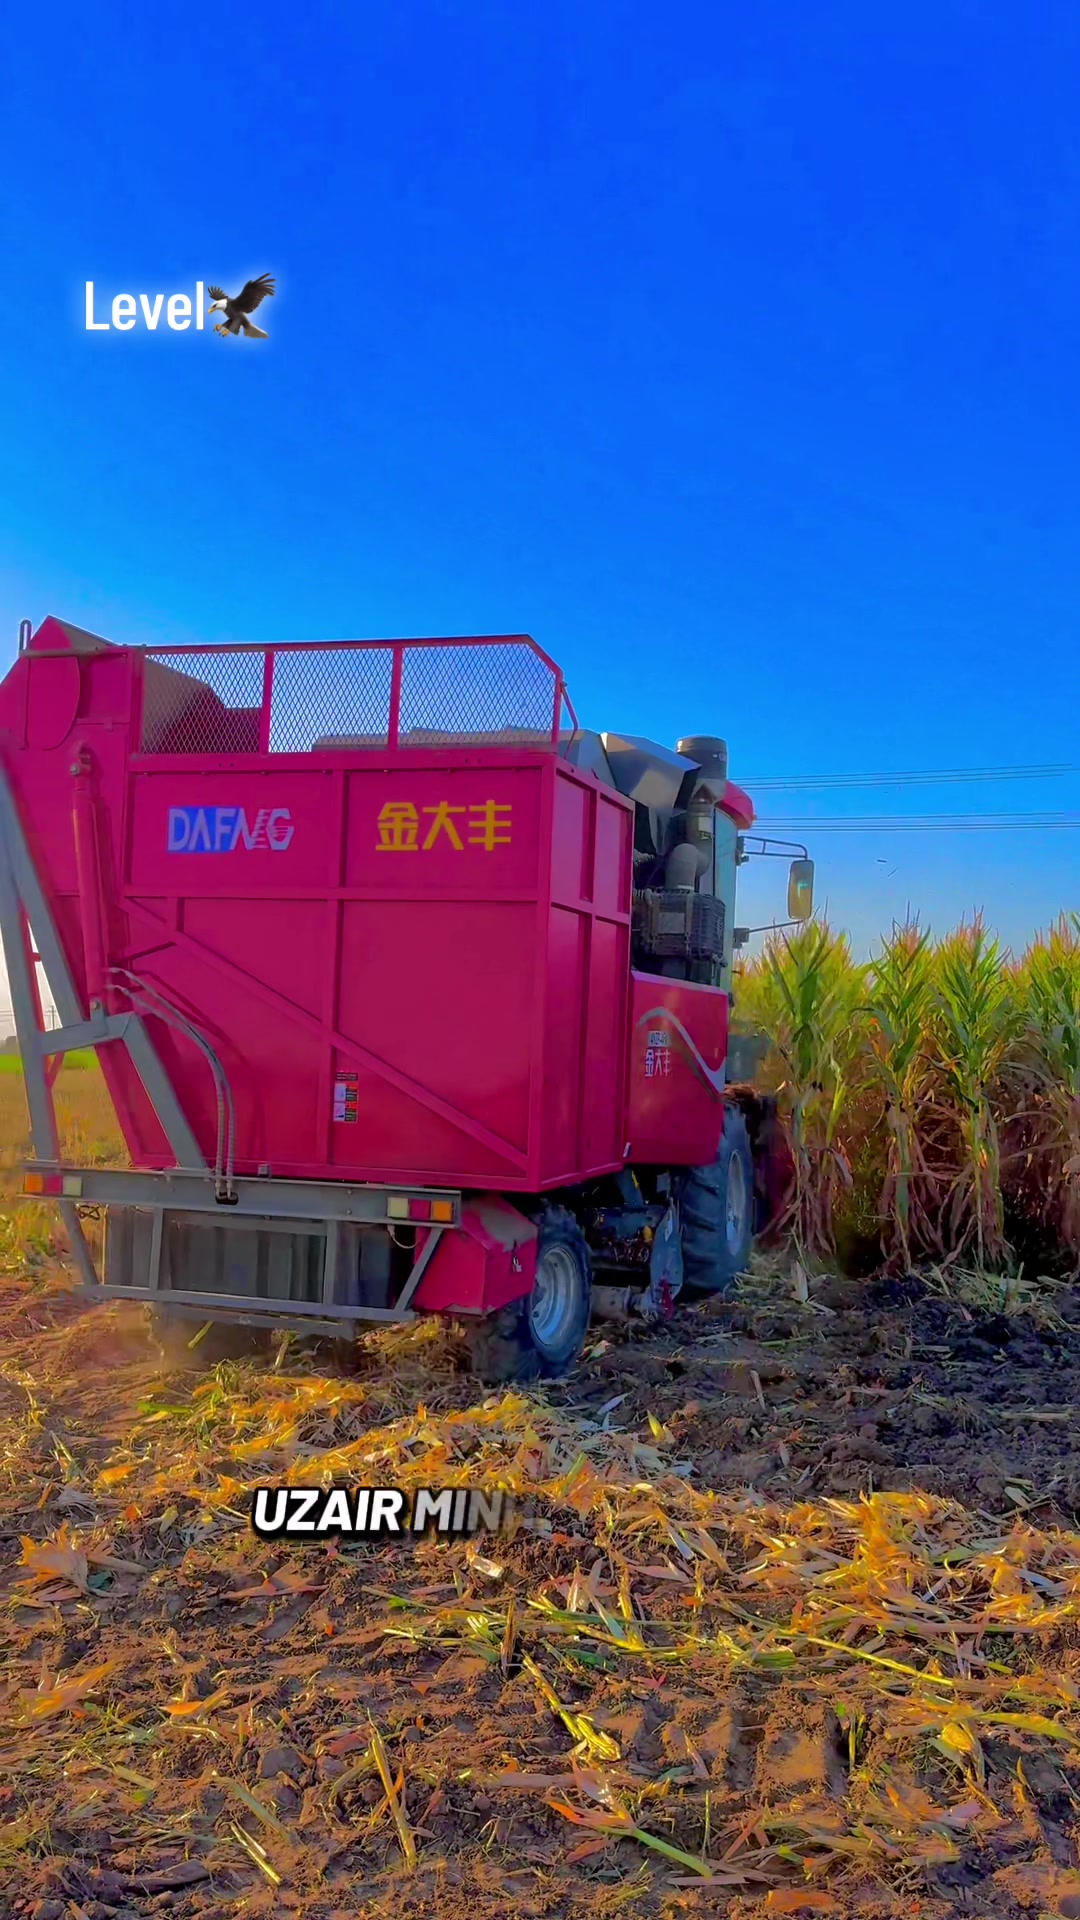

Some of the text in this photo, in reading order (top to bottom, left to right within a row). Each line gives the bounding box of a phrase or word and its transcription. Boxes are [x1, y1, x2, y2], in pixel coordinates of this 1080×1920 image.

[375, 799, 513, 851] 金大丰
[644, 1048, 671, 1077] 金大丰
